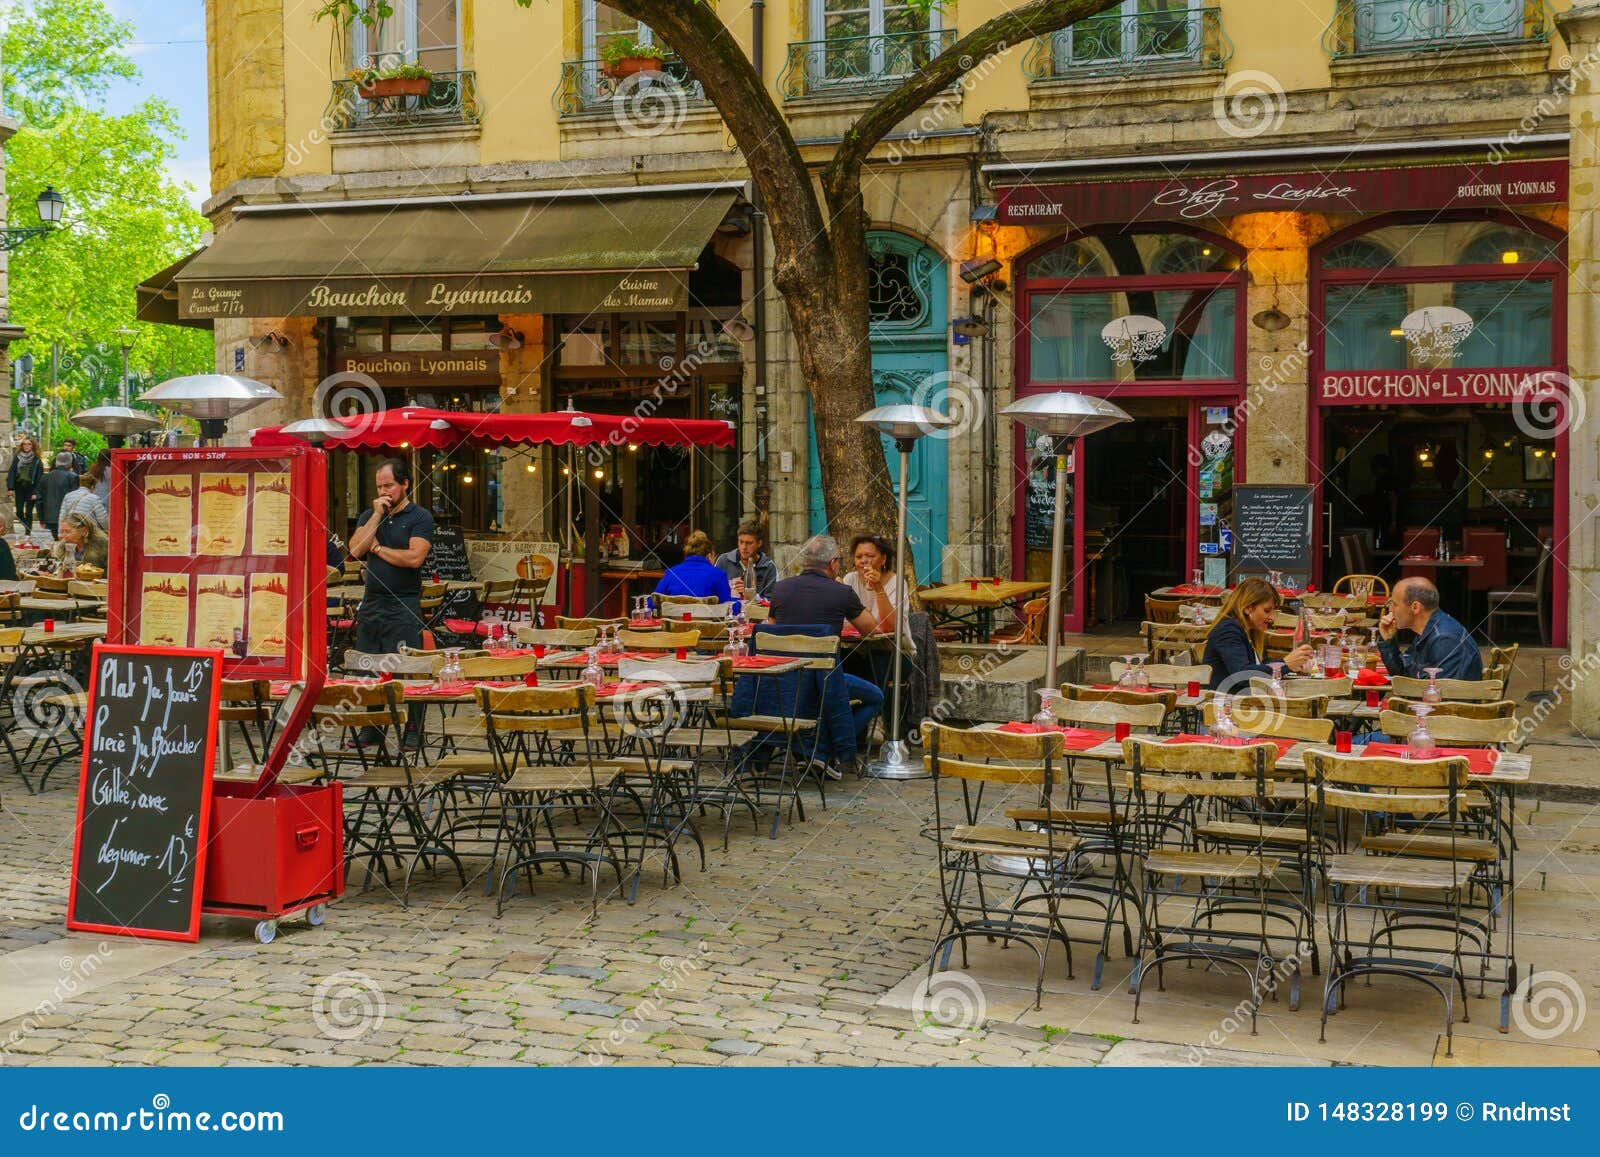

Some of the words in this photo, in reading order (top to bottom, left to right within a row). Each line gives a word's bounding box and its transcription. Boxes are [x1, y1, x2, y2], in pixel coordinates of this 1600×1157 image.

[1458, 183, 1502, 198] BOUCHON
[1507, 180, 1556, 195] LYONNAIS
[1008, 203, 1063, 217] RESTAURANT
[619, 279, 659, 291] Cuisine
[191, 287, 205, 299] La
[208, 286, 242, 302] Grange
[307, 285, 407, 308] Bouchon
[425, 283, 533, 312] Lyonnais
[603, 294, 621, 307] des
[624, 294, 674, 307] Mamans
[346, 359, 411, 373] Bouchon
[420, 358, 488, 374] Lyonnais
[136, 452, 174, 461] SERVICE
[100, 658, 136, 698] Plat
